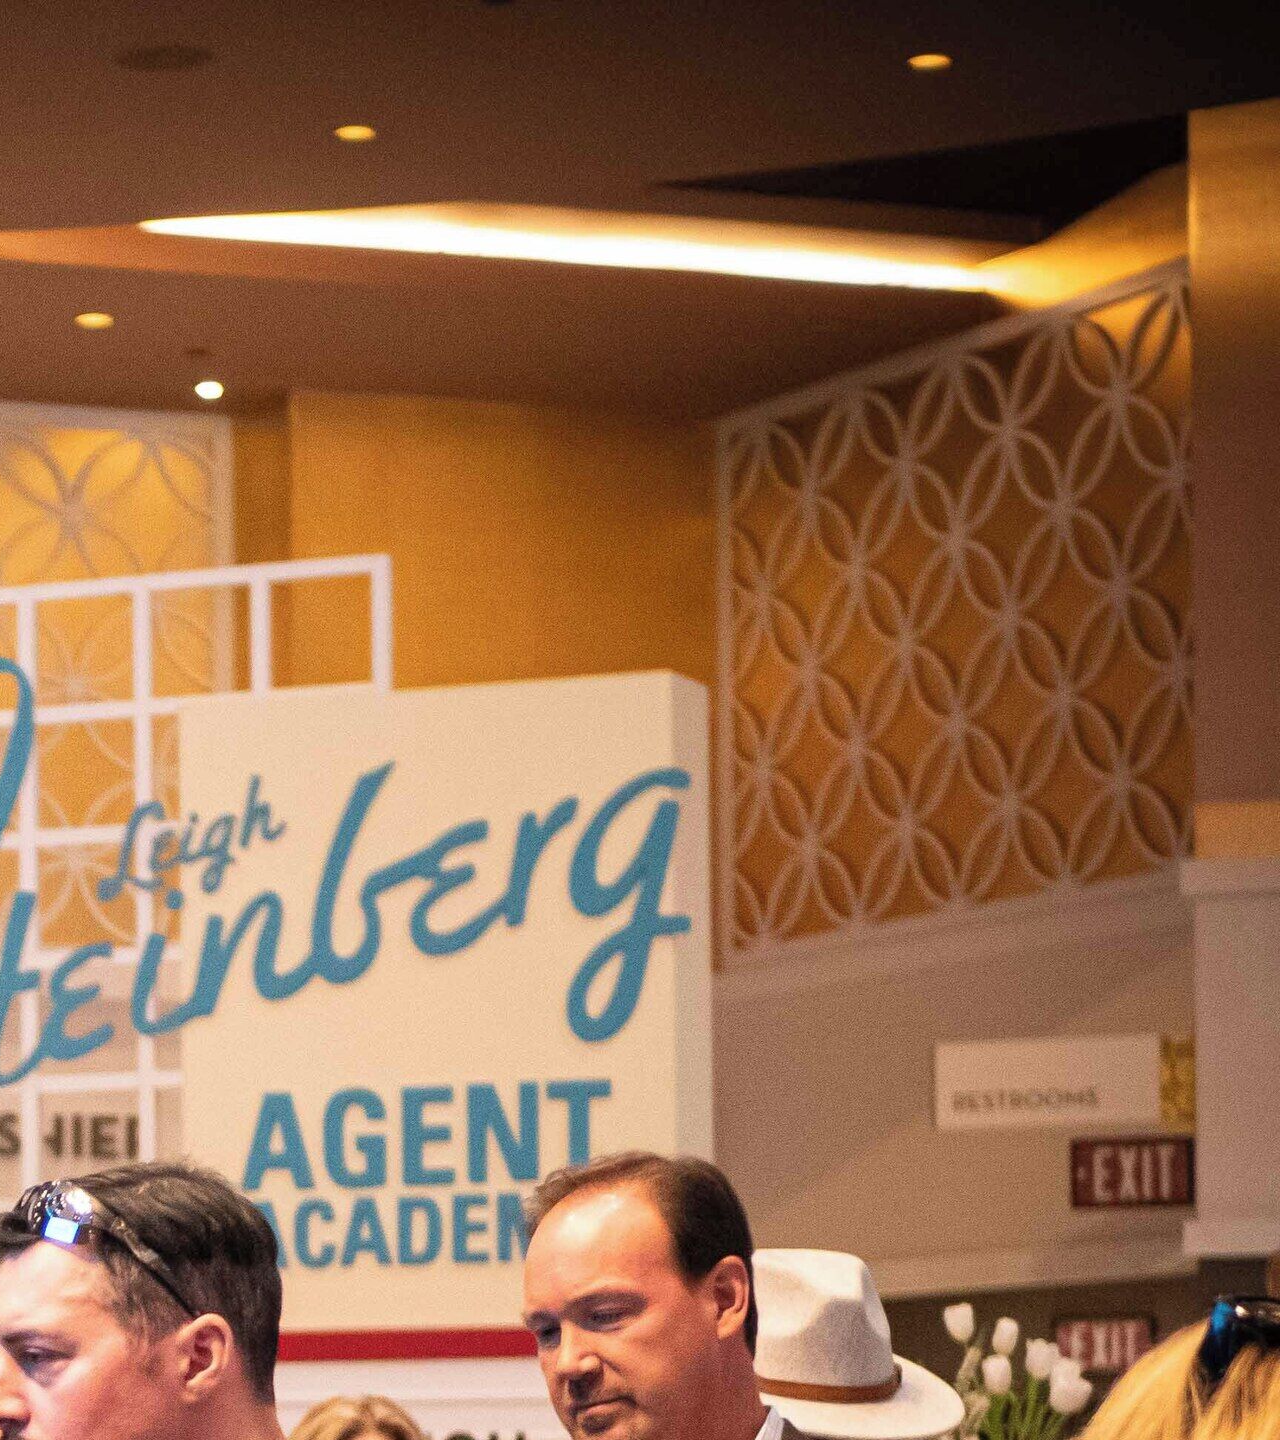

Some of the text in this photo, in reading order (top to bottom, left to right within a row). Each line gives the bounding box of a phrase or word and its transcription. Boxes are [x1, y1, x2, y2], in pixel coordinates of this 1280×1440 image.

[96, 774, 287, 903] Leigh
[243, 1079, 612, 1191] AGENT
[1093, 1146, 1175, 1200] EXIT
